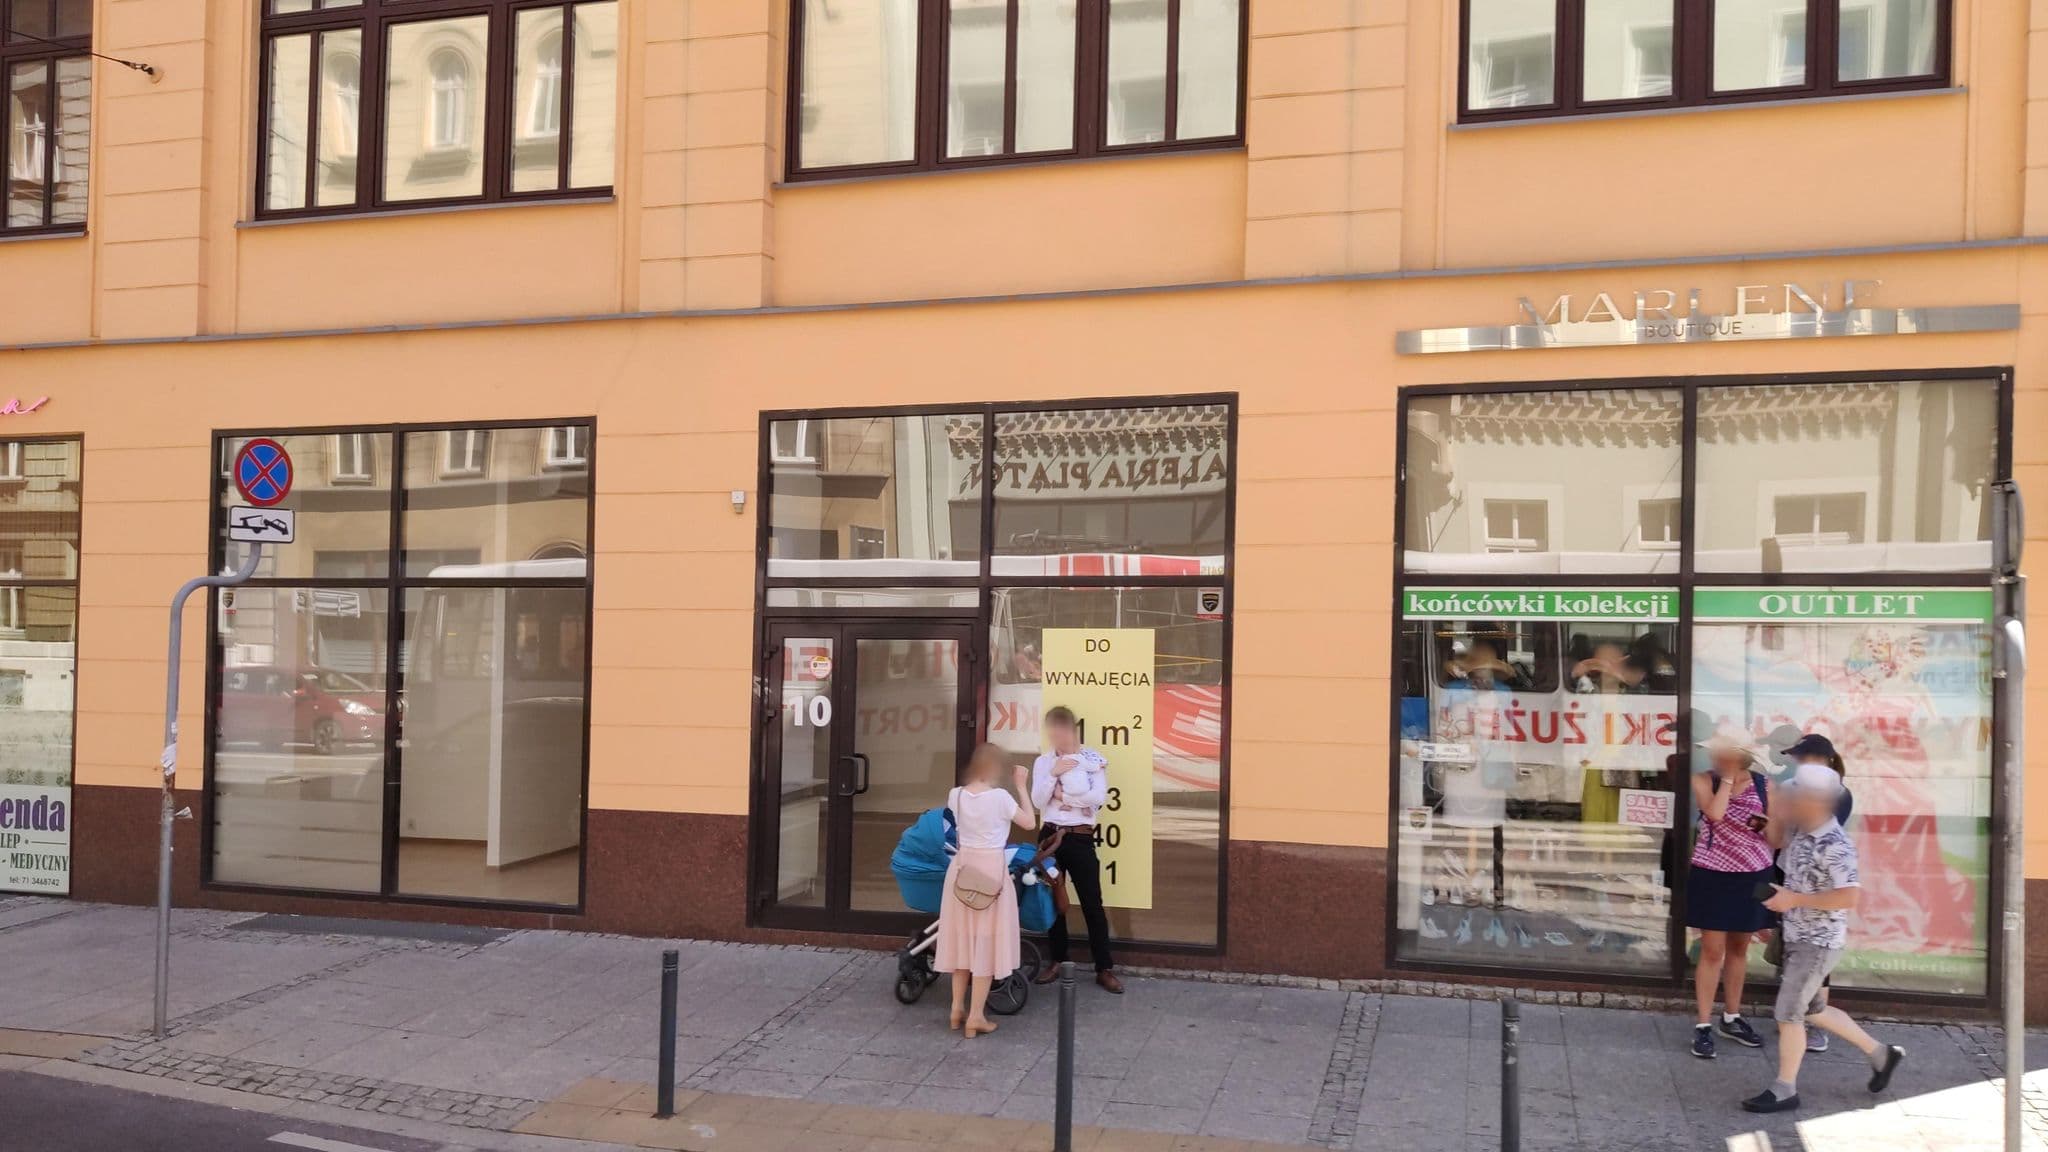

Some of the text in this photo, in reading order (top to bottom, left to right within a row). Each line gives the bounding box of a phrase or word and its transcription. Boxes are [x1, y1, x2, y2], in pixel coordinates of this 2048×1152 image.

[1645, 321, 1743, 338] BOUTIQUE
[1410, 593, 1669, 618] końcówki kolekcji
[1759, 594, 1924, 615] OUTLET
[1085, 638, 1111, 652] DO
[1045, 671, 1151, 689] WYNAJĘCIA
[792, 695, 832, 727] 10
[1625, 794, 1668, 810] SALE
[10, 852, 69, 872] MEDYCZNY
